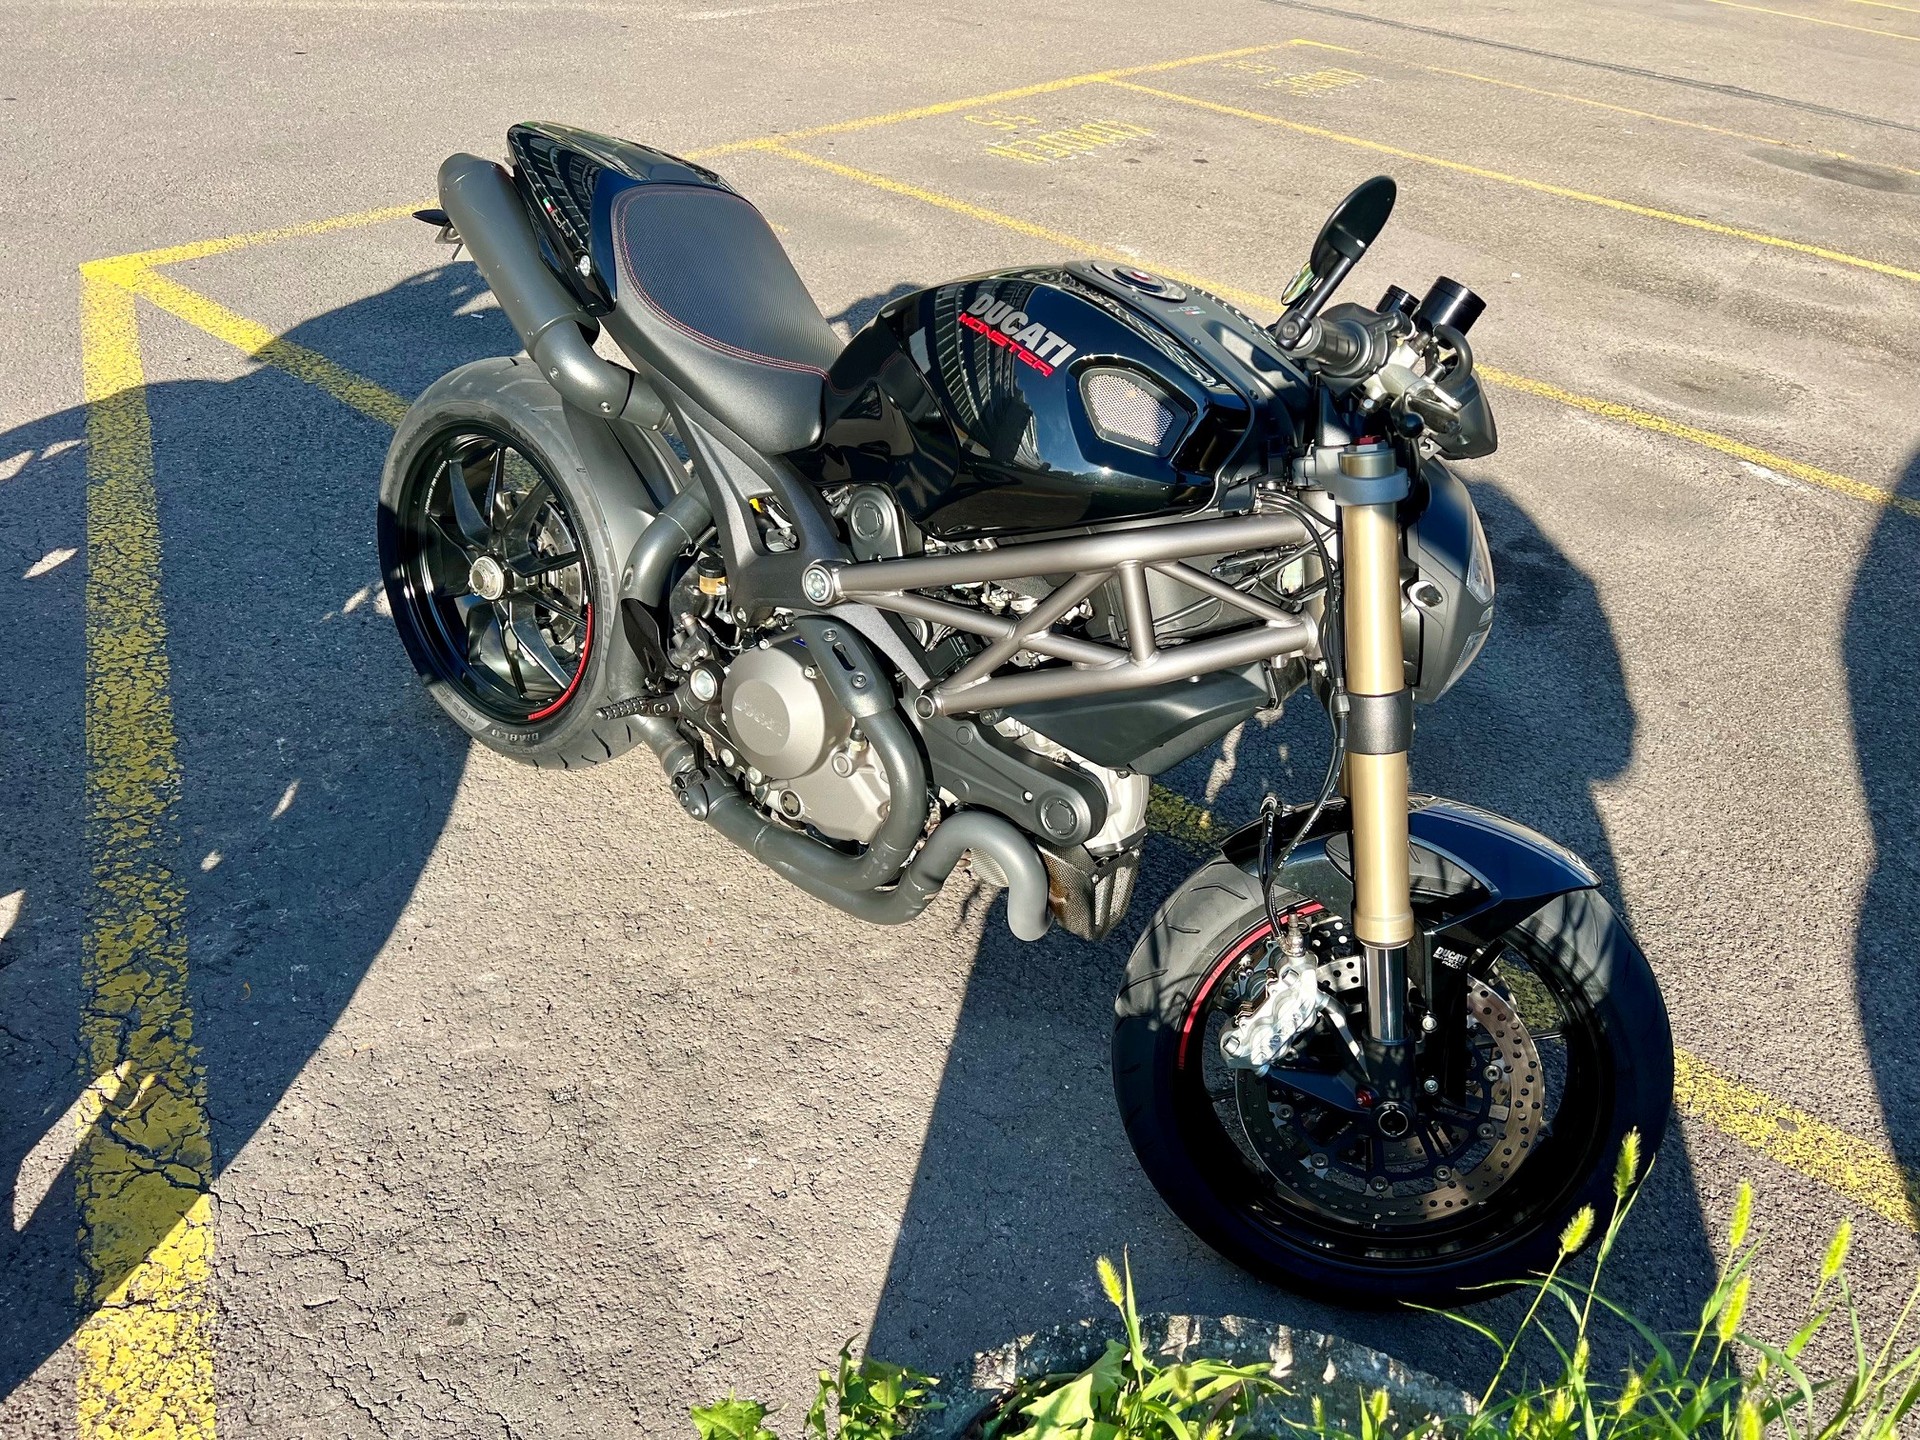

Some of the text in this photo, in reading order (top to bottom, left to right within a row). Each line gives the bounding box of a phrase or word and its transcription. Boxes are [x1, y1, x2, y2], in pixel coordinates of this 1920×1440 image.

[957, 312, 1056, 378] MONSTER
[967, 293, 1077, 368] DUCATI
[490, 728, 539, 742] DIABLO
[1434, 946, 1468, 964] DUCATI
